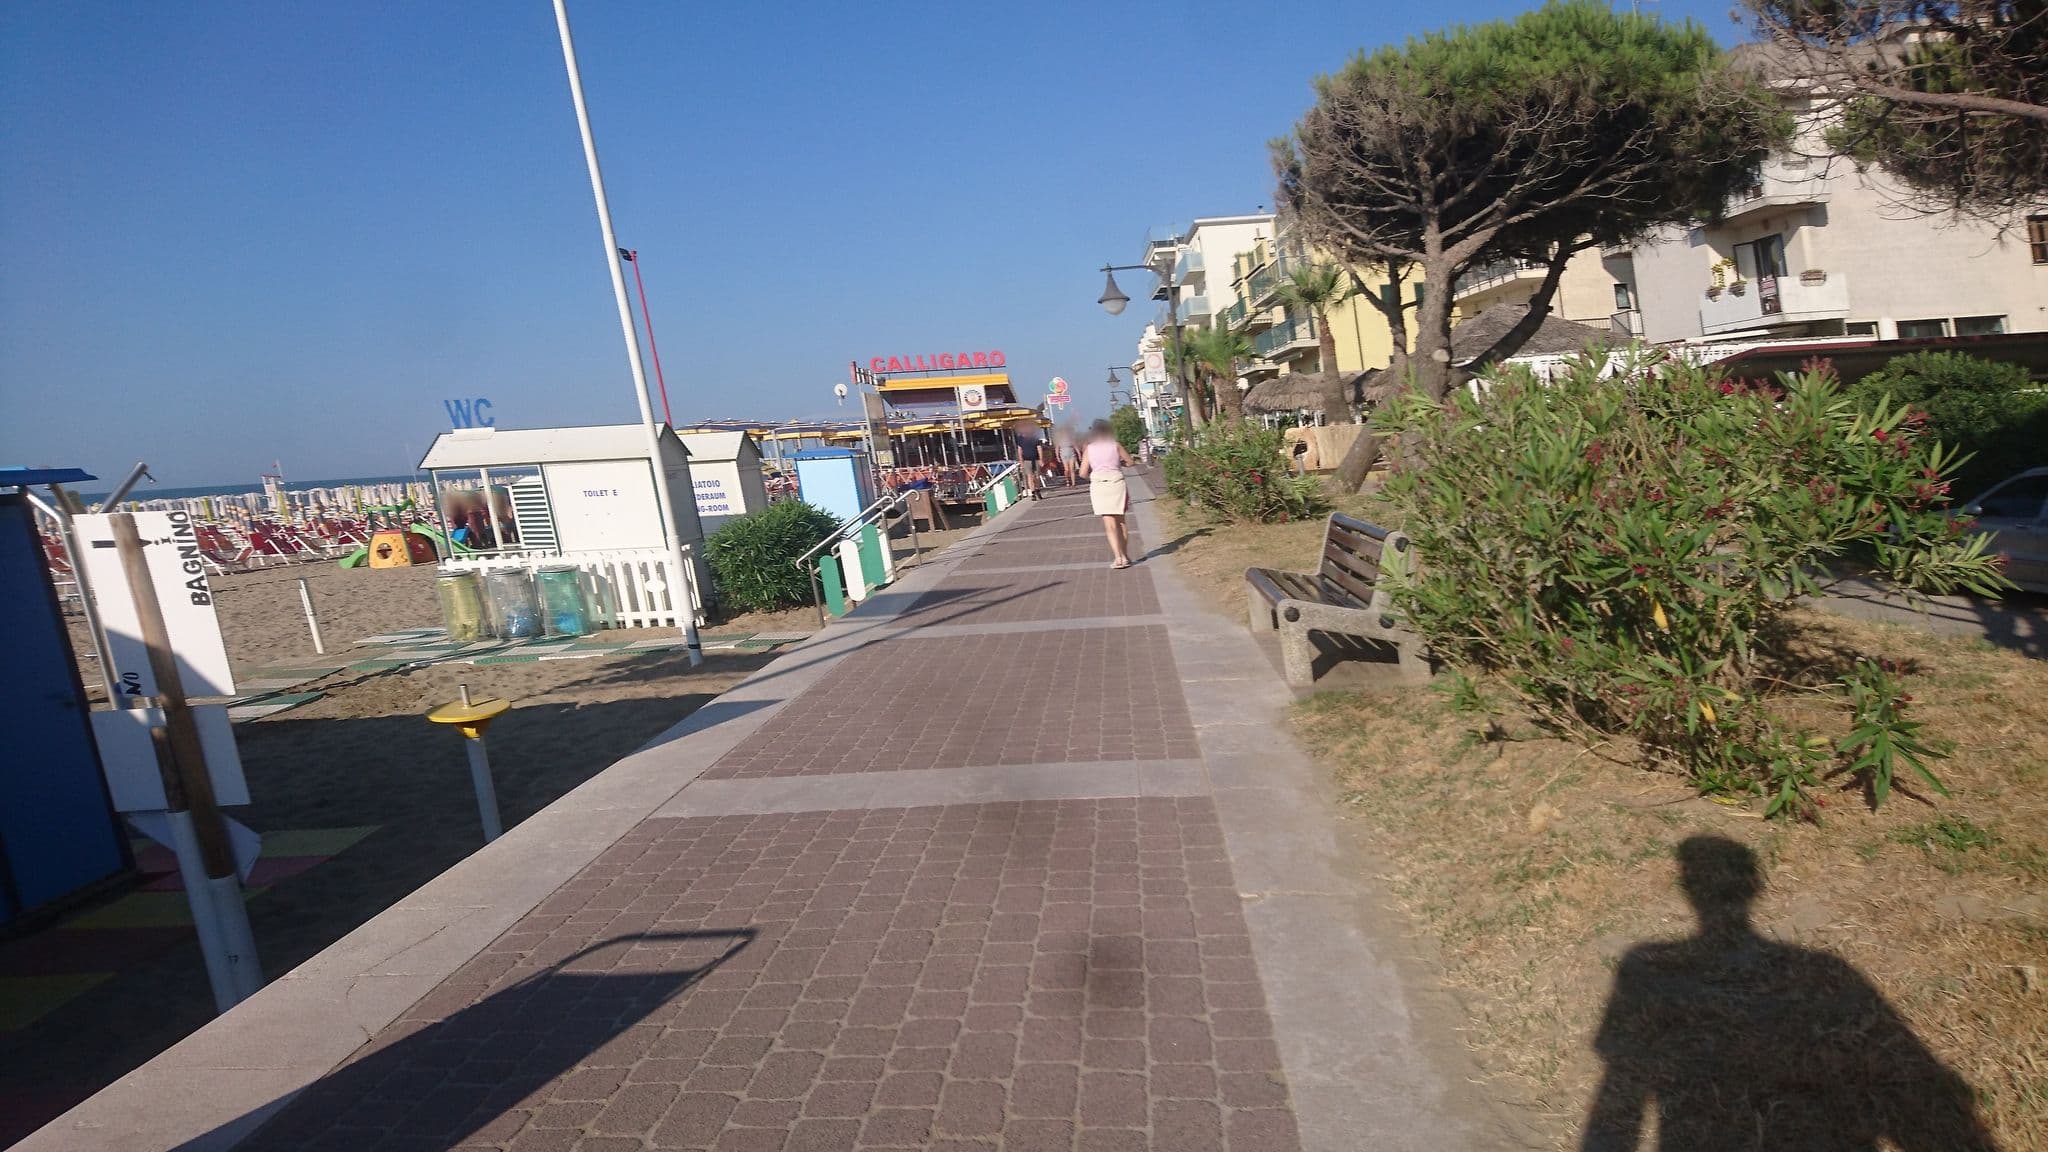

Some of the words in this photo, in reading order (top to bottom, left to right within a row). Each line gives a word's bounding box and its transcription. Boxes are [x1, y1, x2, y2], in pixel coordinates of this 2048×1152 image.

[870, 351, 1005, 373] CALLIGARO
[444, 399, 495, 428] WC
[583, 489, 608, 497] TOILET
[695, 492, 727, 501] DERAUM
